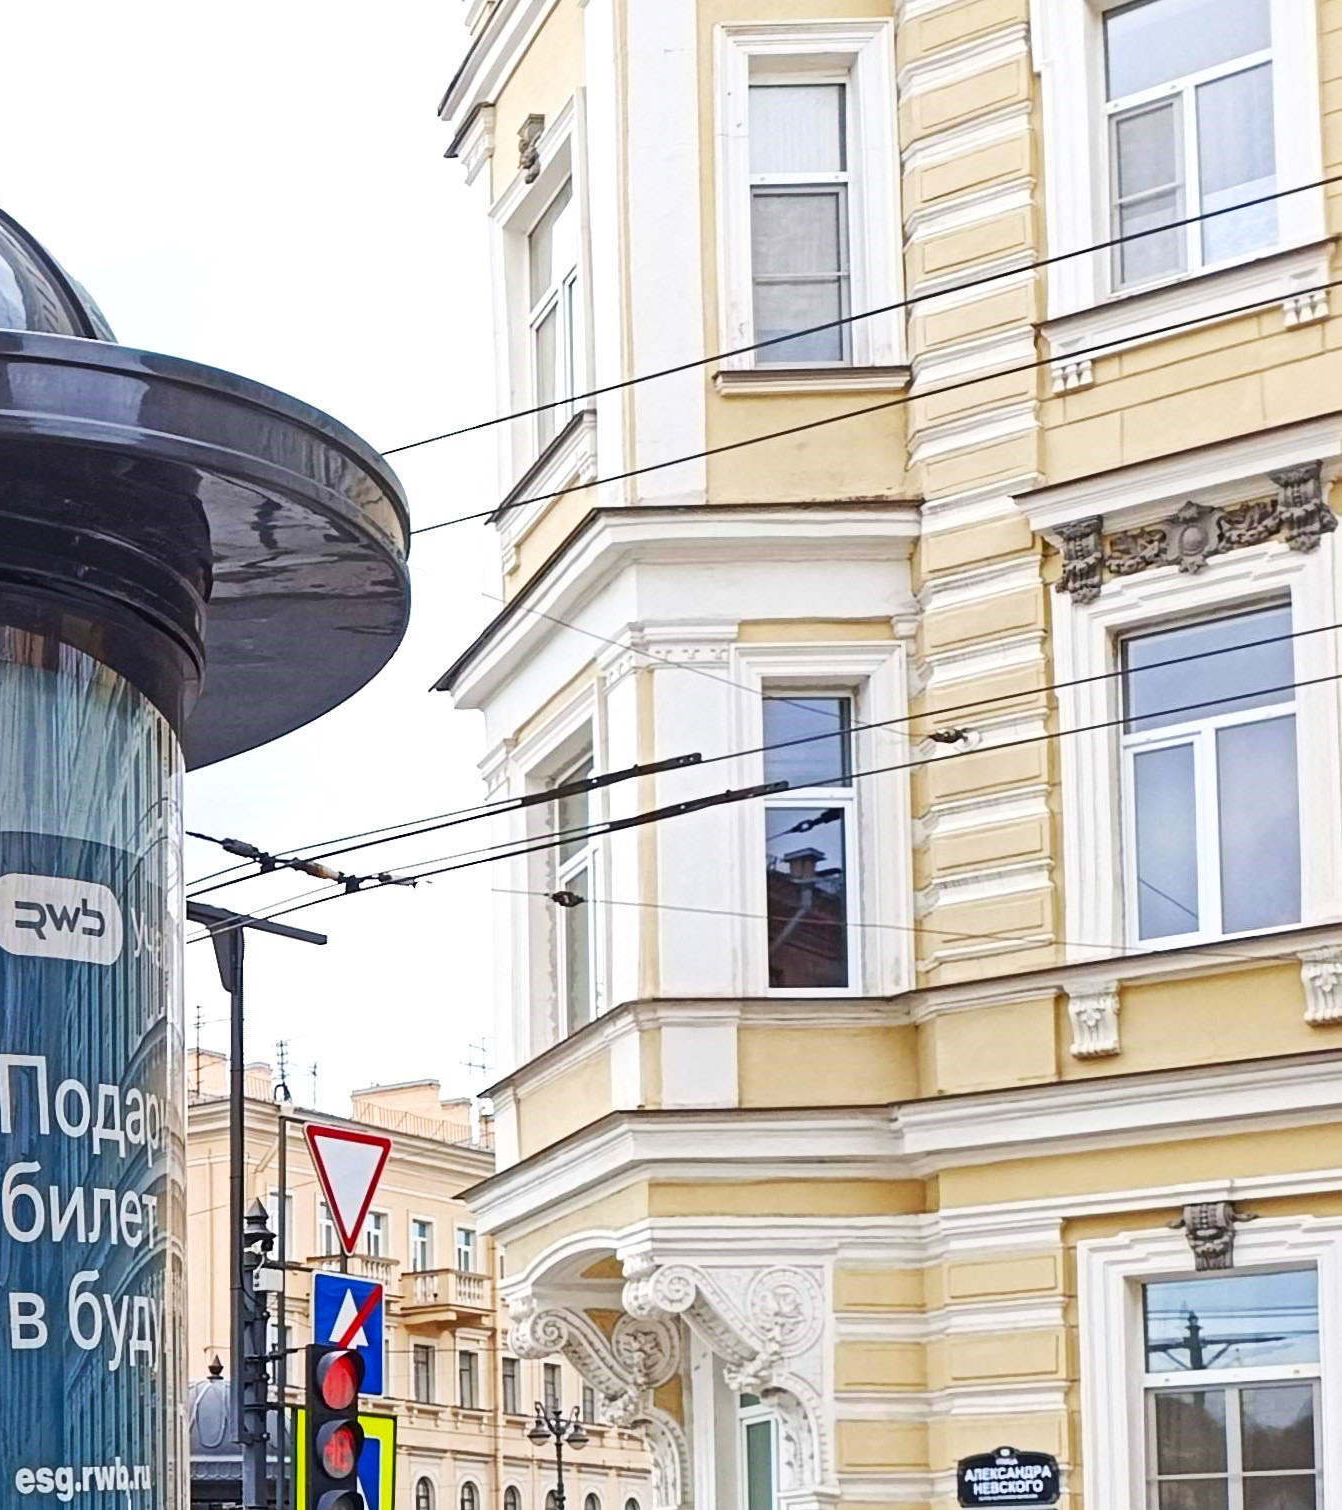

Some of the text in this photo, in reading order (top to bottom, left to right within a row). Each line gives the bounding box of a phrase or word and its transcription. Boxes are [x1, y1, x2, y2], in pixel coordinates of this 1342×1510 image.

[2, 1160, 157, 1249] билет
[8, 1292, 48, 1350] в
[15, 1456, 151, 1502] esg.rwb.ru
[964, 1465, 1052, 1482] АЛЕКСАНДРА
[973, 1479, 1044, 1496] НЕВСКОГО
